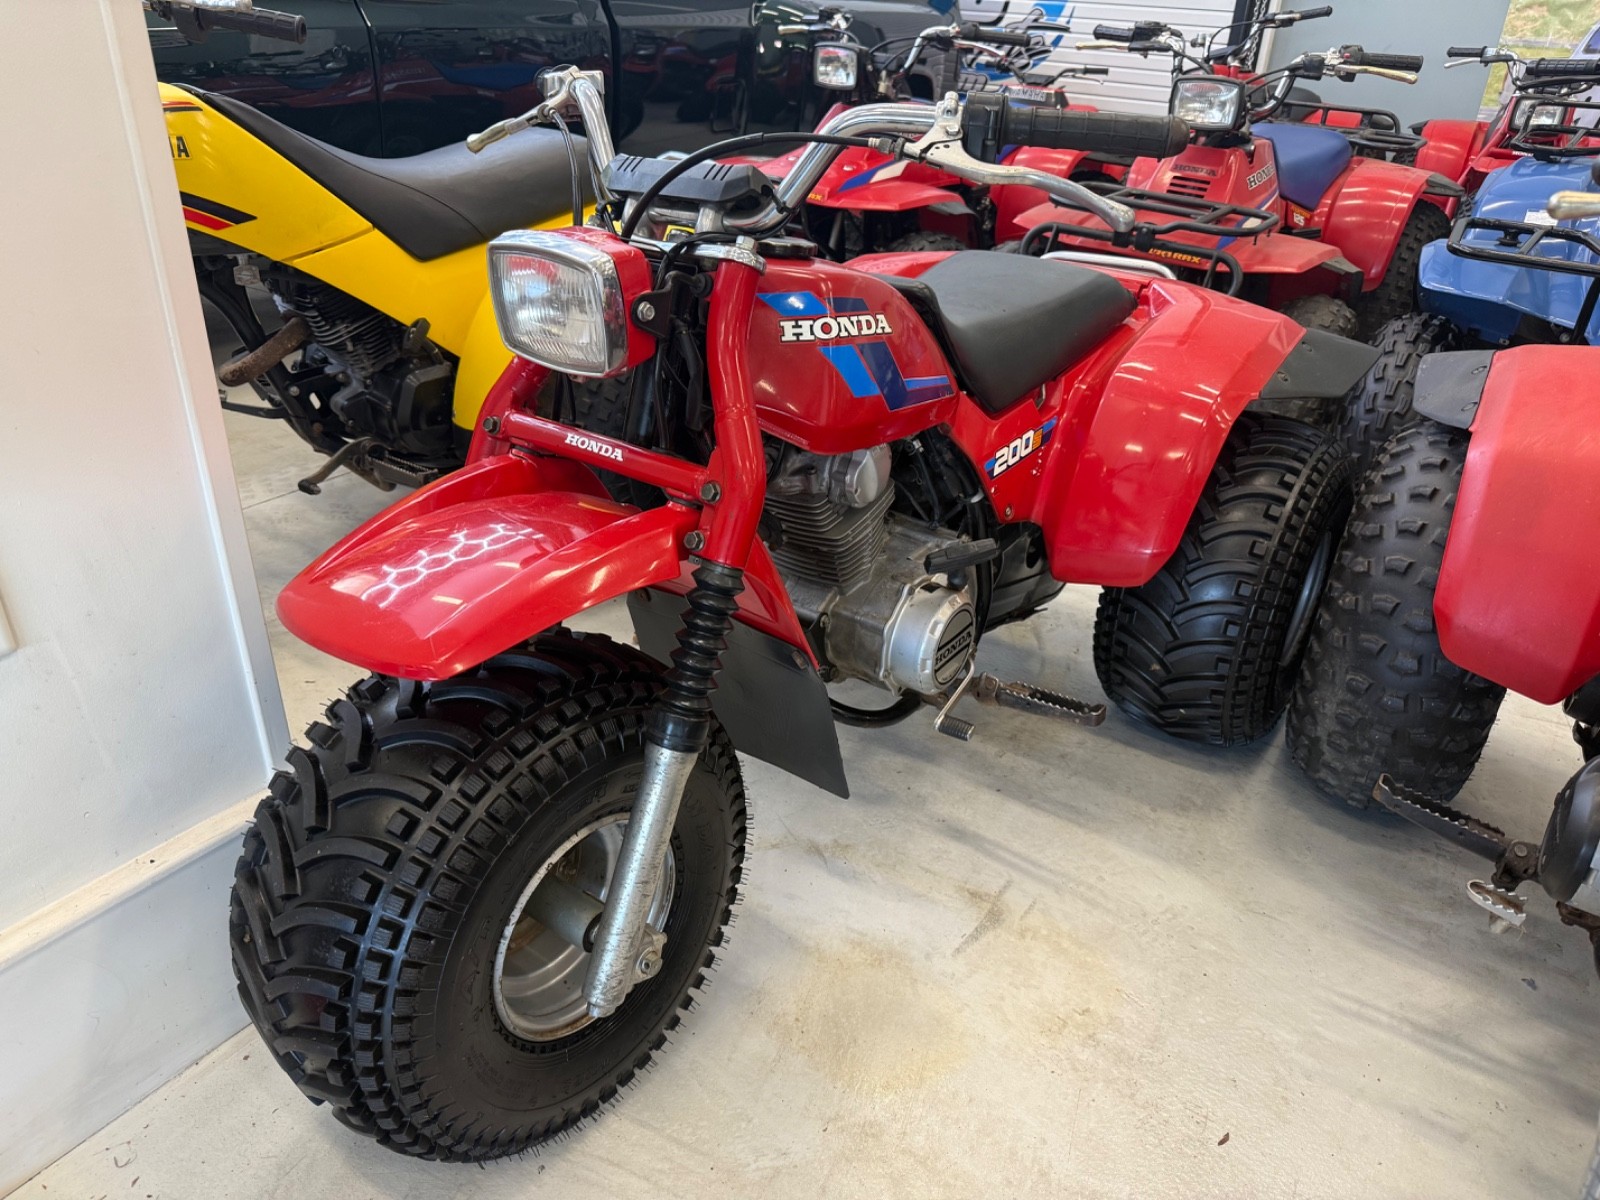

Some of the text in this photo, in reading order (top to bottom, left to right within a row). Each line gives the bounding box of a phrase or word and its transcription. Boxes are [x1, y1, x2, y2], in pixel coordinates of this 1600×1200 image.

[780, 314, 893, 342] HONDA
[565, 432, 624, 462] HONDA
[935, 630, 972, 665] HONDA
